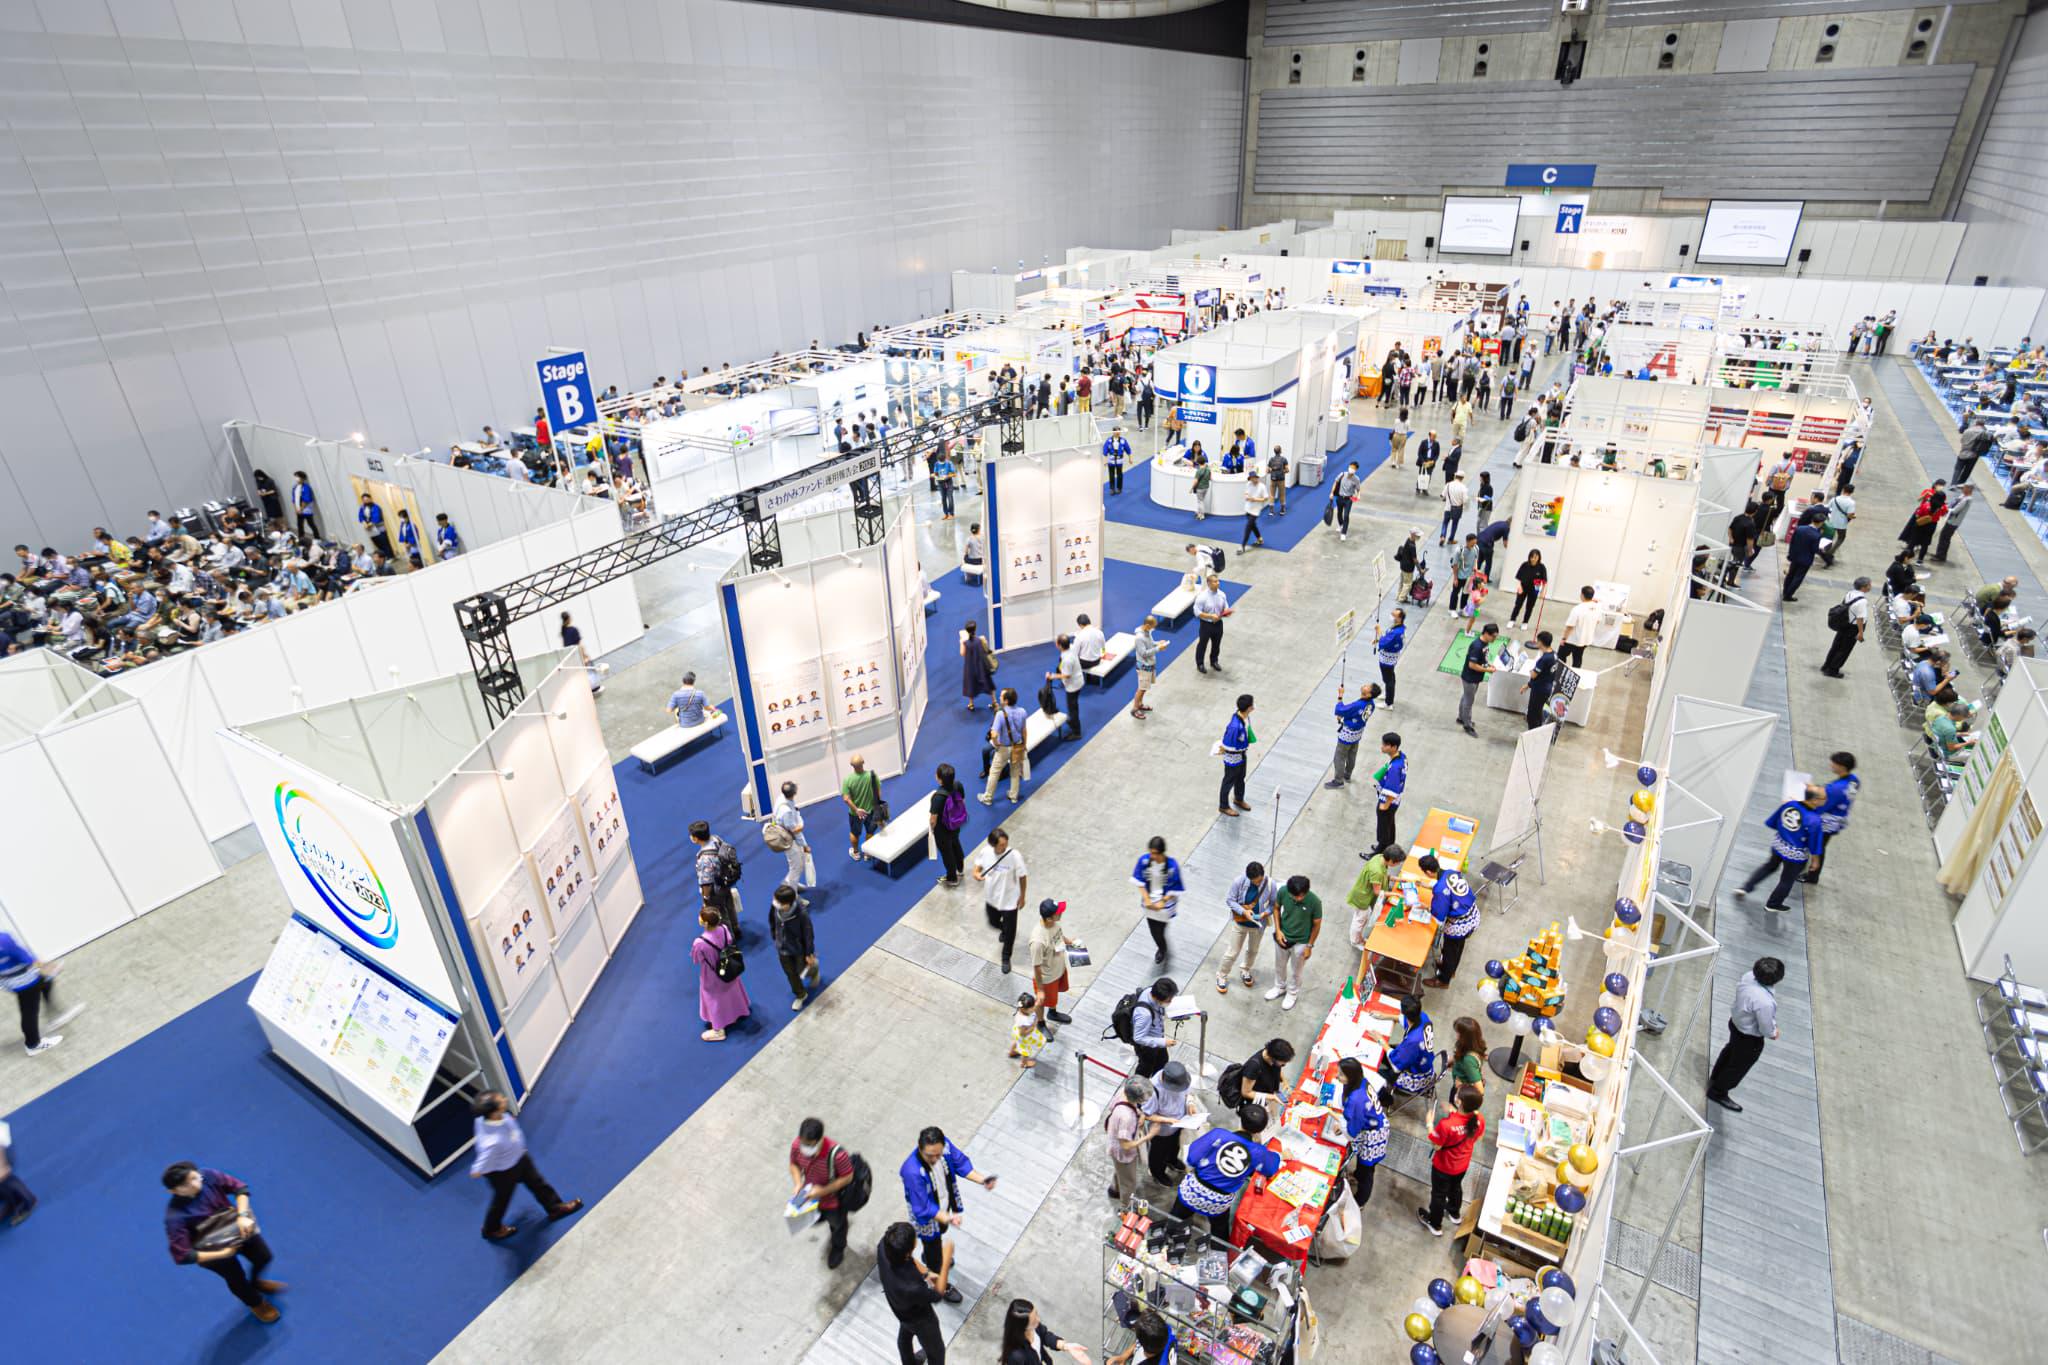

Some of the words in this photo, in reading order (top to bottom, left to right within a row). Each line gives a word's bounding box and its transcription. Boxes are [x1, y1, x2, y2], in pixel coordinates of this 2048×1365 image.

[1542, 167, 1558, 184] C
[1560, 206, 1581, 216] Stage
[1561, 215, 1574, 232] A
[543, 361, 584, 383] Stage
[557, 385, 584, 424] B
[1531, 501, 1555, 510] Come
